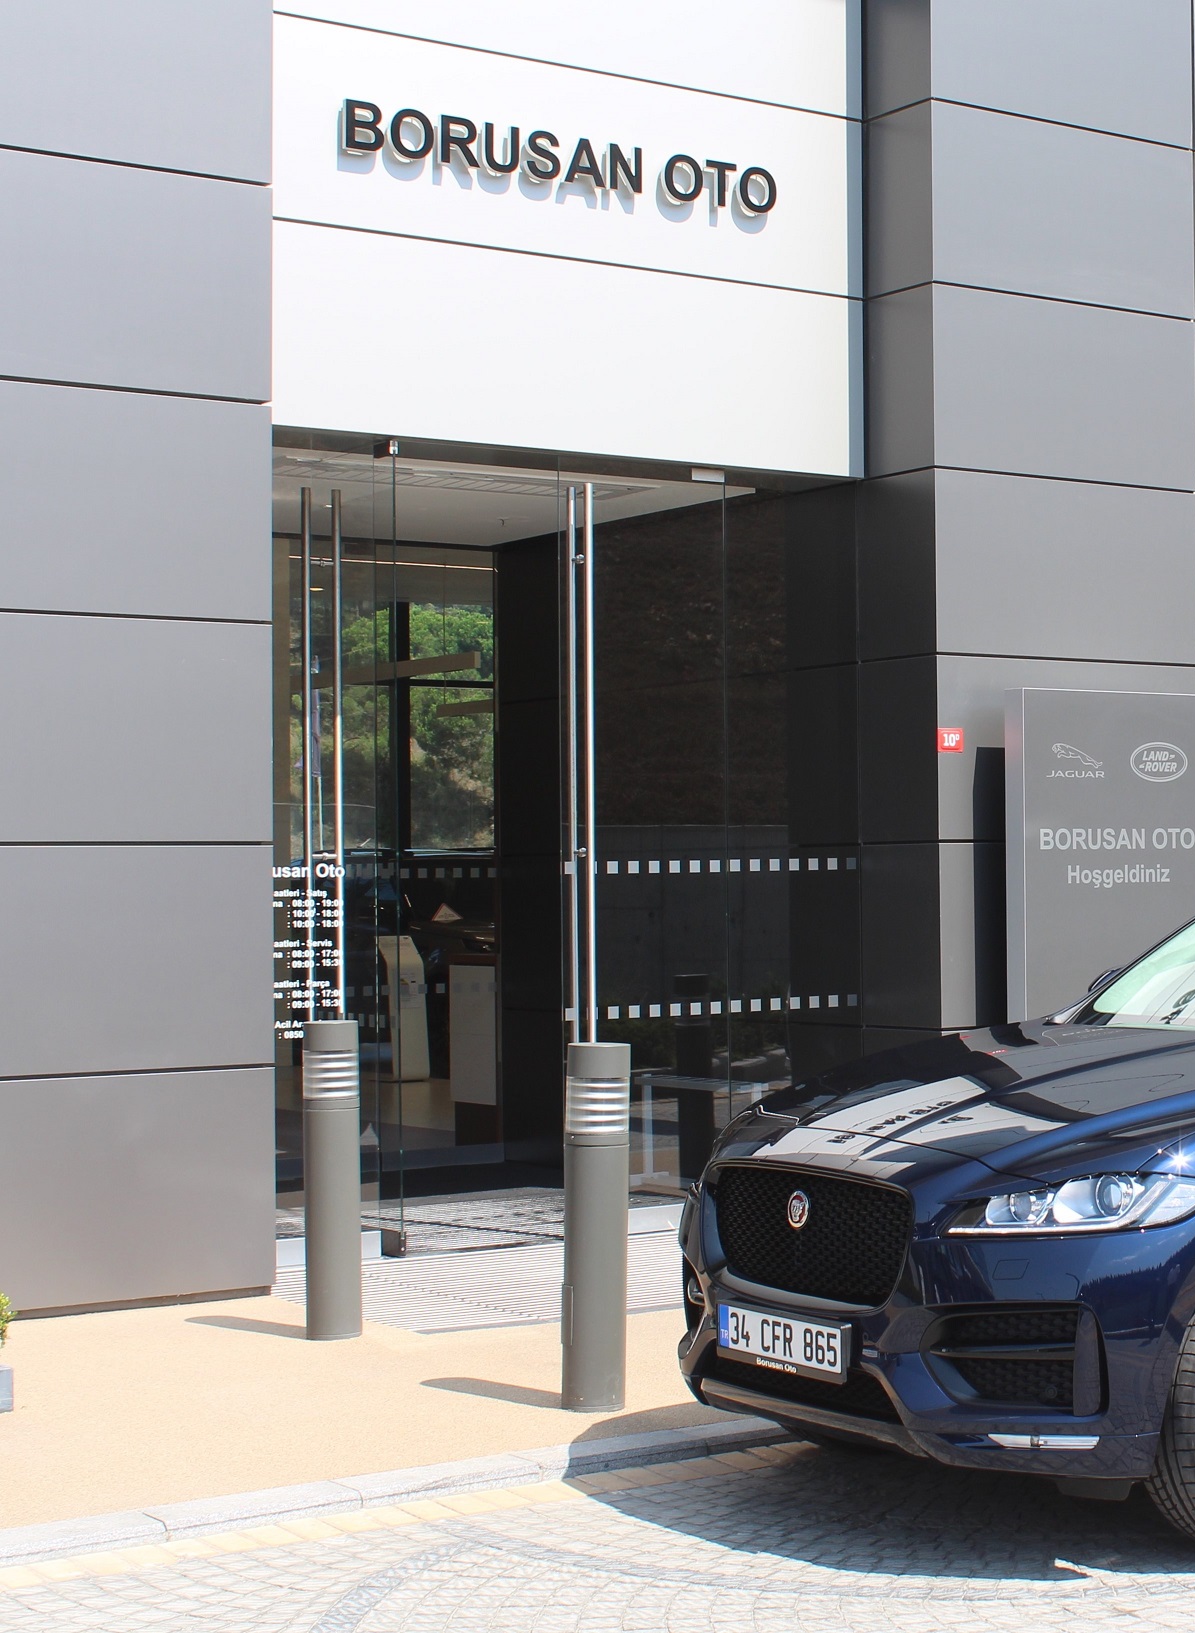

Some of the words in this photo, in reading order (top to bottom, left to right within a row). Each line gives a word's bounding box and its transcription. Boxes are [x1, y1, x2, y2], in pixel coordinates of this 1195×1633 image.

[343, 98, 643, 194] BORUSAN
[662, 153, 778, 214] OTO
[1142, 750, 1169, 761] LAND
[1144, 761, 1178, 773] ROVER
[1046, 770, 1105, 779] JAGUAR
[1039, 828, 1146, 850] BORUSAN
[1152, 827, 1195, 849] OTO
[315, 863, 346, 878] Oto
[1067, 864, 1171, 889] Hoşgeldiniz
[274, 1020, 291, 1028] Acil
[292, 1020, 304, 1028] Ar
[284, 1031, 304, 1039] 0850
[720, 1328, 729, 1340] TR
[730, 1312, 751, 1348] 34
[761, 1318, 793, 1358] CFR
[803, 1327, 838, 1368] 865
[756, 1357, 784, 1371] Borusan
[784, 1363, 797, 1374] Oto
